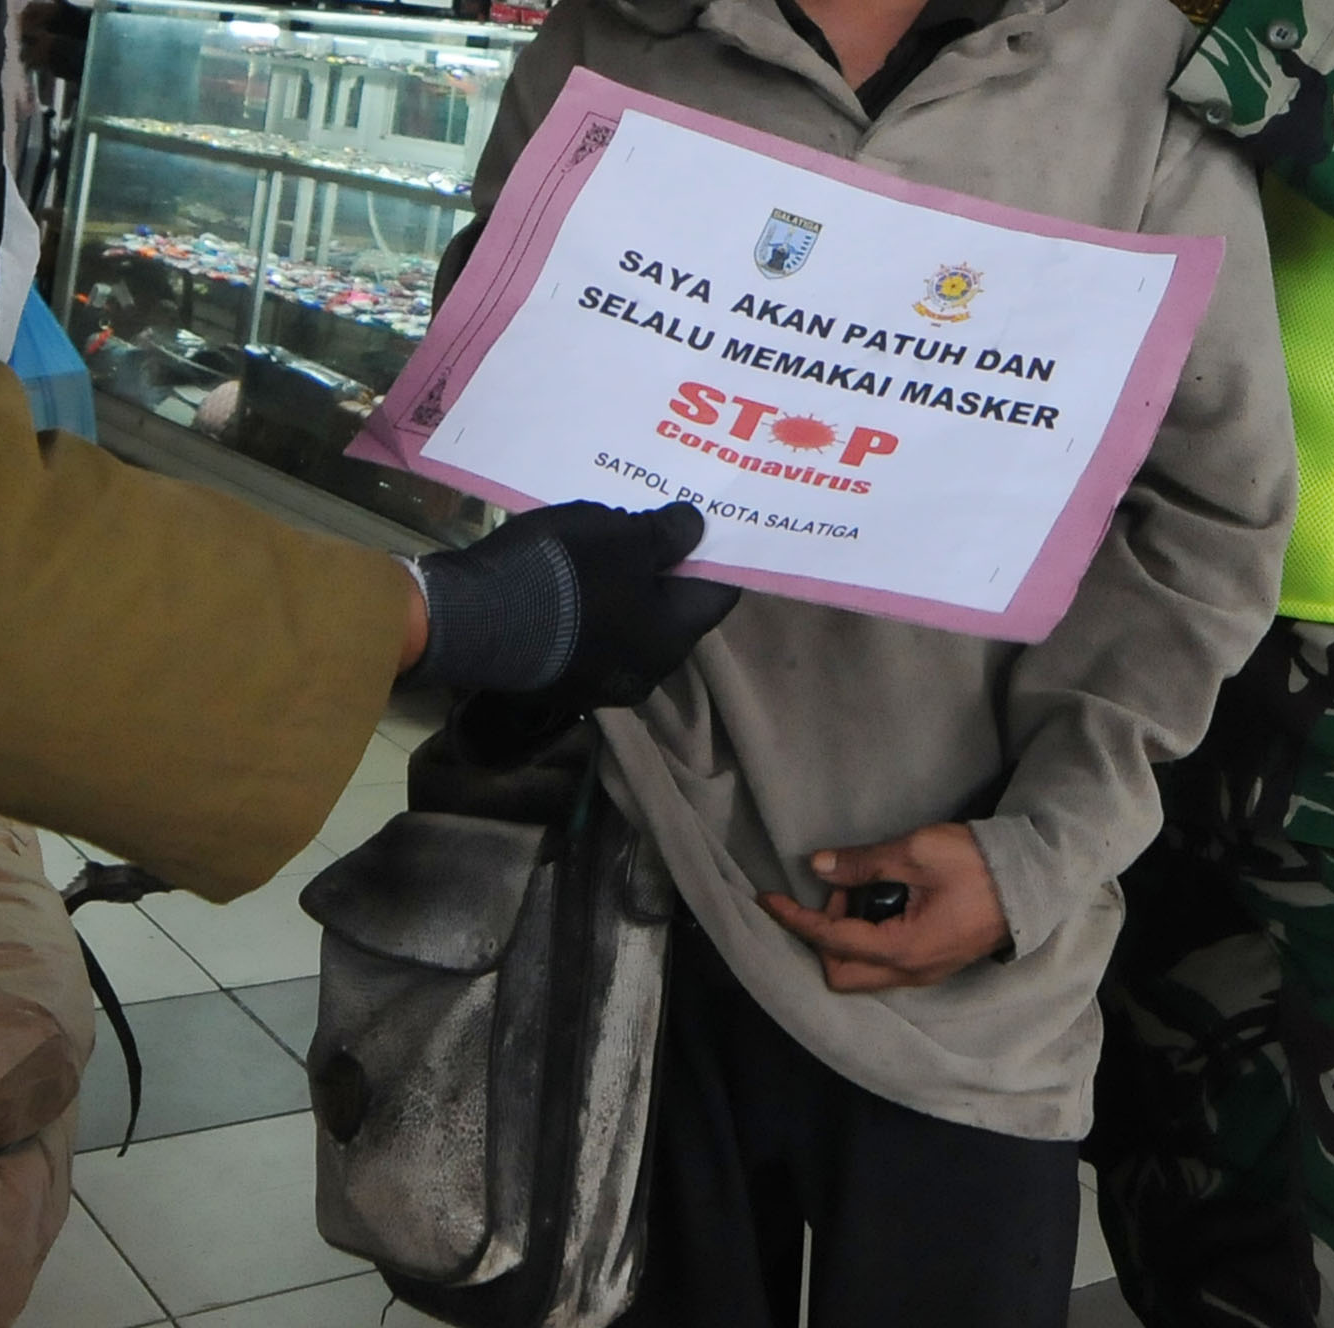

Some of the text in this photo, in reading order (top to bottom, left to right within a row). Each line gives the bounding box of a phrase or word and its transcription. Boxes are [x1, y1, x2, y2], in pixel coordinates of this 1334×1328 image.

[772, 209, 820, 233] SALATIGA
[578, 286, 1060, 430] SELALU MEMAKAI MASKER
[619, 250, 1056, 382] SAYA AKAN PATUH DAN
[594, 452, 860, 540] SATPOL PP KOTA SALATIGA
[655, 418, 873, 495] Coronavirus
